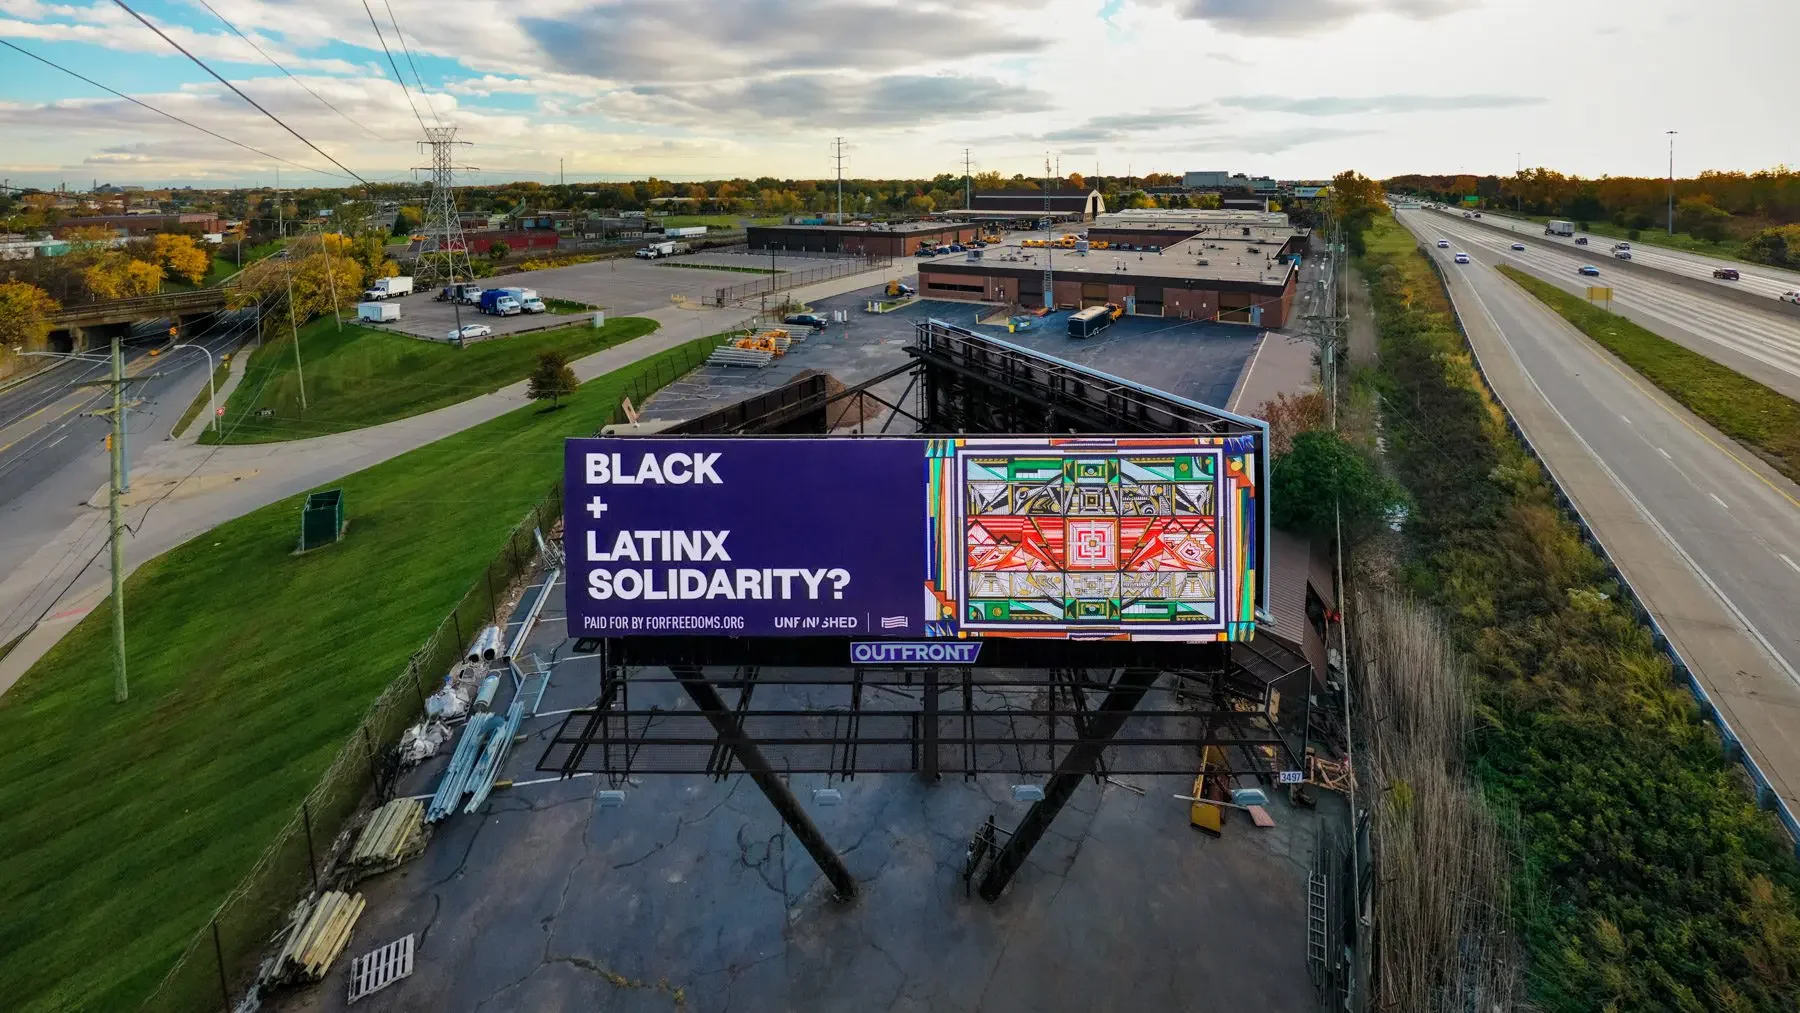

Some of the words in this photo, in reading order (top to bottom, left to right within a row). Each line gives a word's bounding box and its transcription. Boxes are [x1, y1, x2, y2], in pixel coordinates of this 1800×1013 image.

[586, 452, 723, 485] BLACK
[586, 496, 608, 519] +
[587, 530, 732, 562] LATINX
[588, 568, 851, 600] SOLIDARITY?
[584, 616, 607, 629] PAID
[609, 616, 629, 629] FOR
[631, 616, 644, 630] BY
[646, 616, 745, 630] FORFREEDOMS.ORG
[855, 644, 975, 661] OUTFRONT
[1281, 772, 1301, 782] 3497
